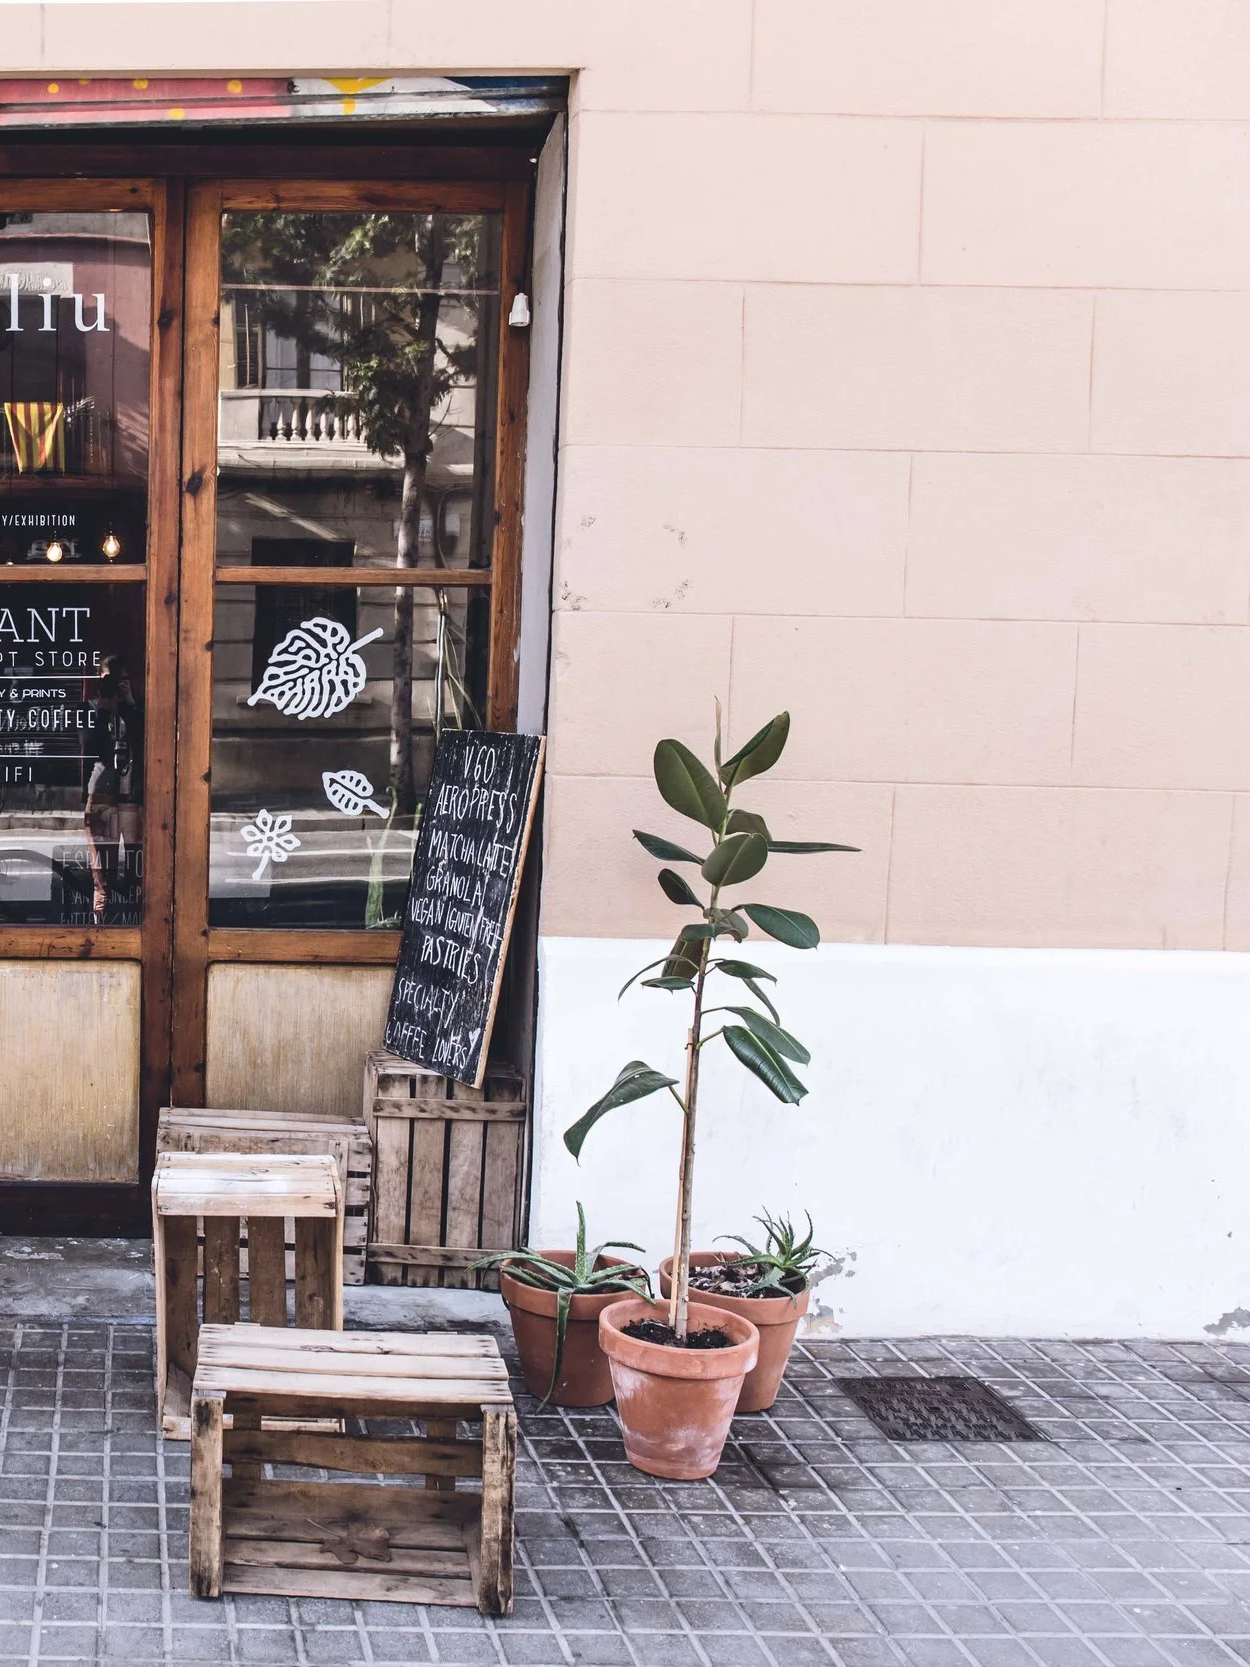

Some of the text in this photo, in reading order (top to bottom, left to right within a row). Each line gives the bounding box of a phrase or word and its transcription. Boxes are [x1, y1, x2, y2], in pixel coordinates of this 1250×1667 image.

[35, 650, 101, 667] STORE
[9, 688, 19, 698] &
[22, 688, 67, 698] PRINTS
[28, 708, 96, 729] COFFEE
[464, 745, 495, 784] V60
[433, 783, 517, 834] AEROPRESS
[428, 828, 513, 879] MATCHA LATTE
[426, 866, 482, 907] GRANOLA
[411, 897, 445, 926] VEGAN
[420, 936, 481, 984] PASTRIES
[395, 978, 459, 1031] SPECIALTY
[386, 1021, 467, 1069] COFFEE LOVERS
